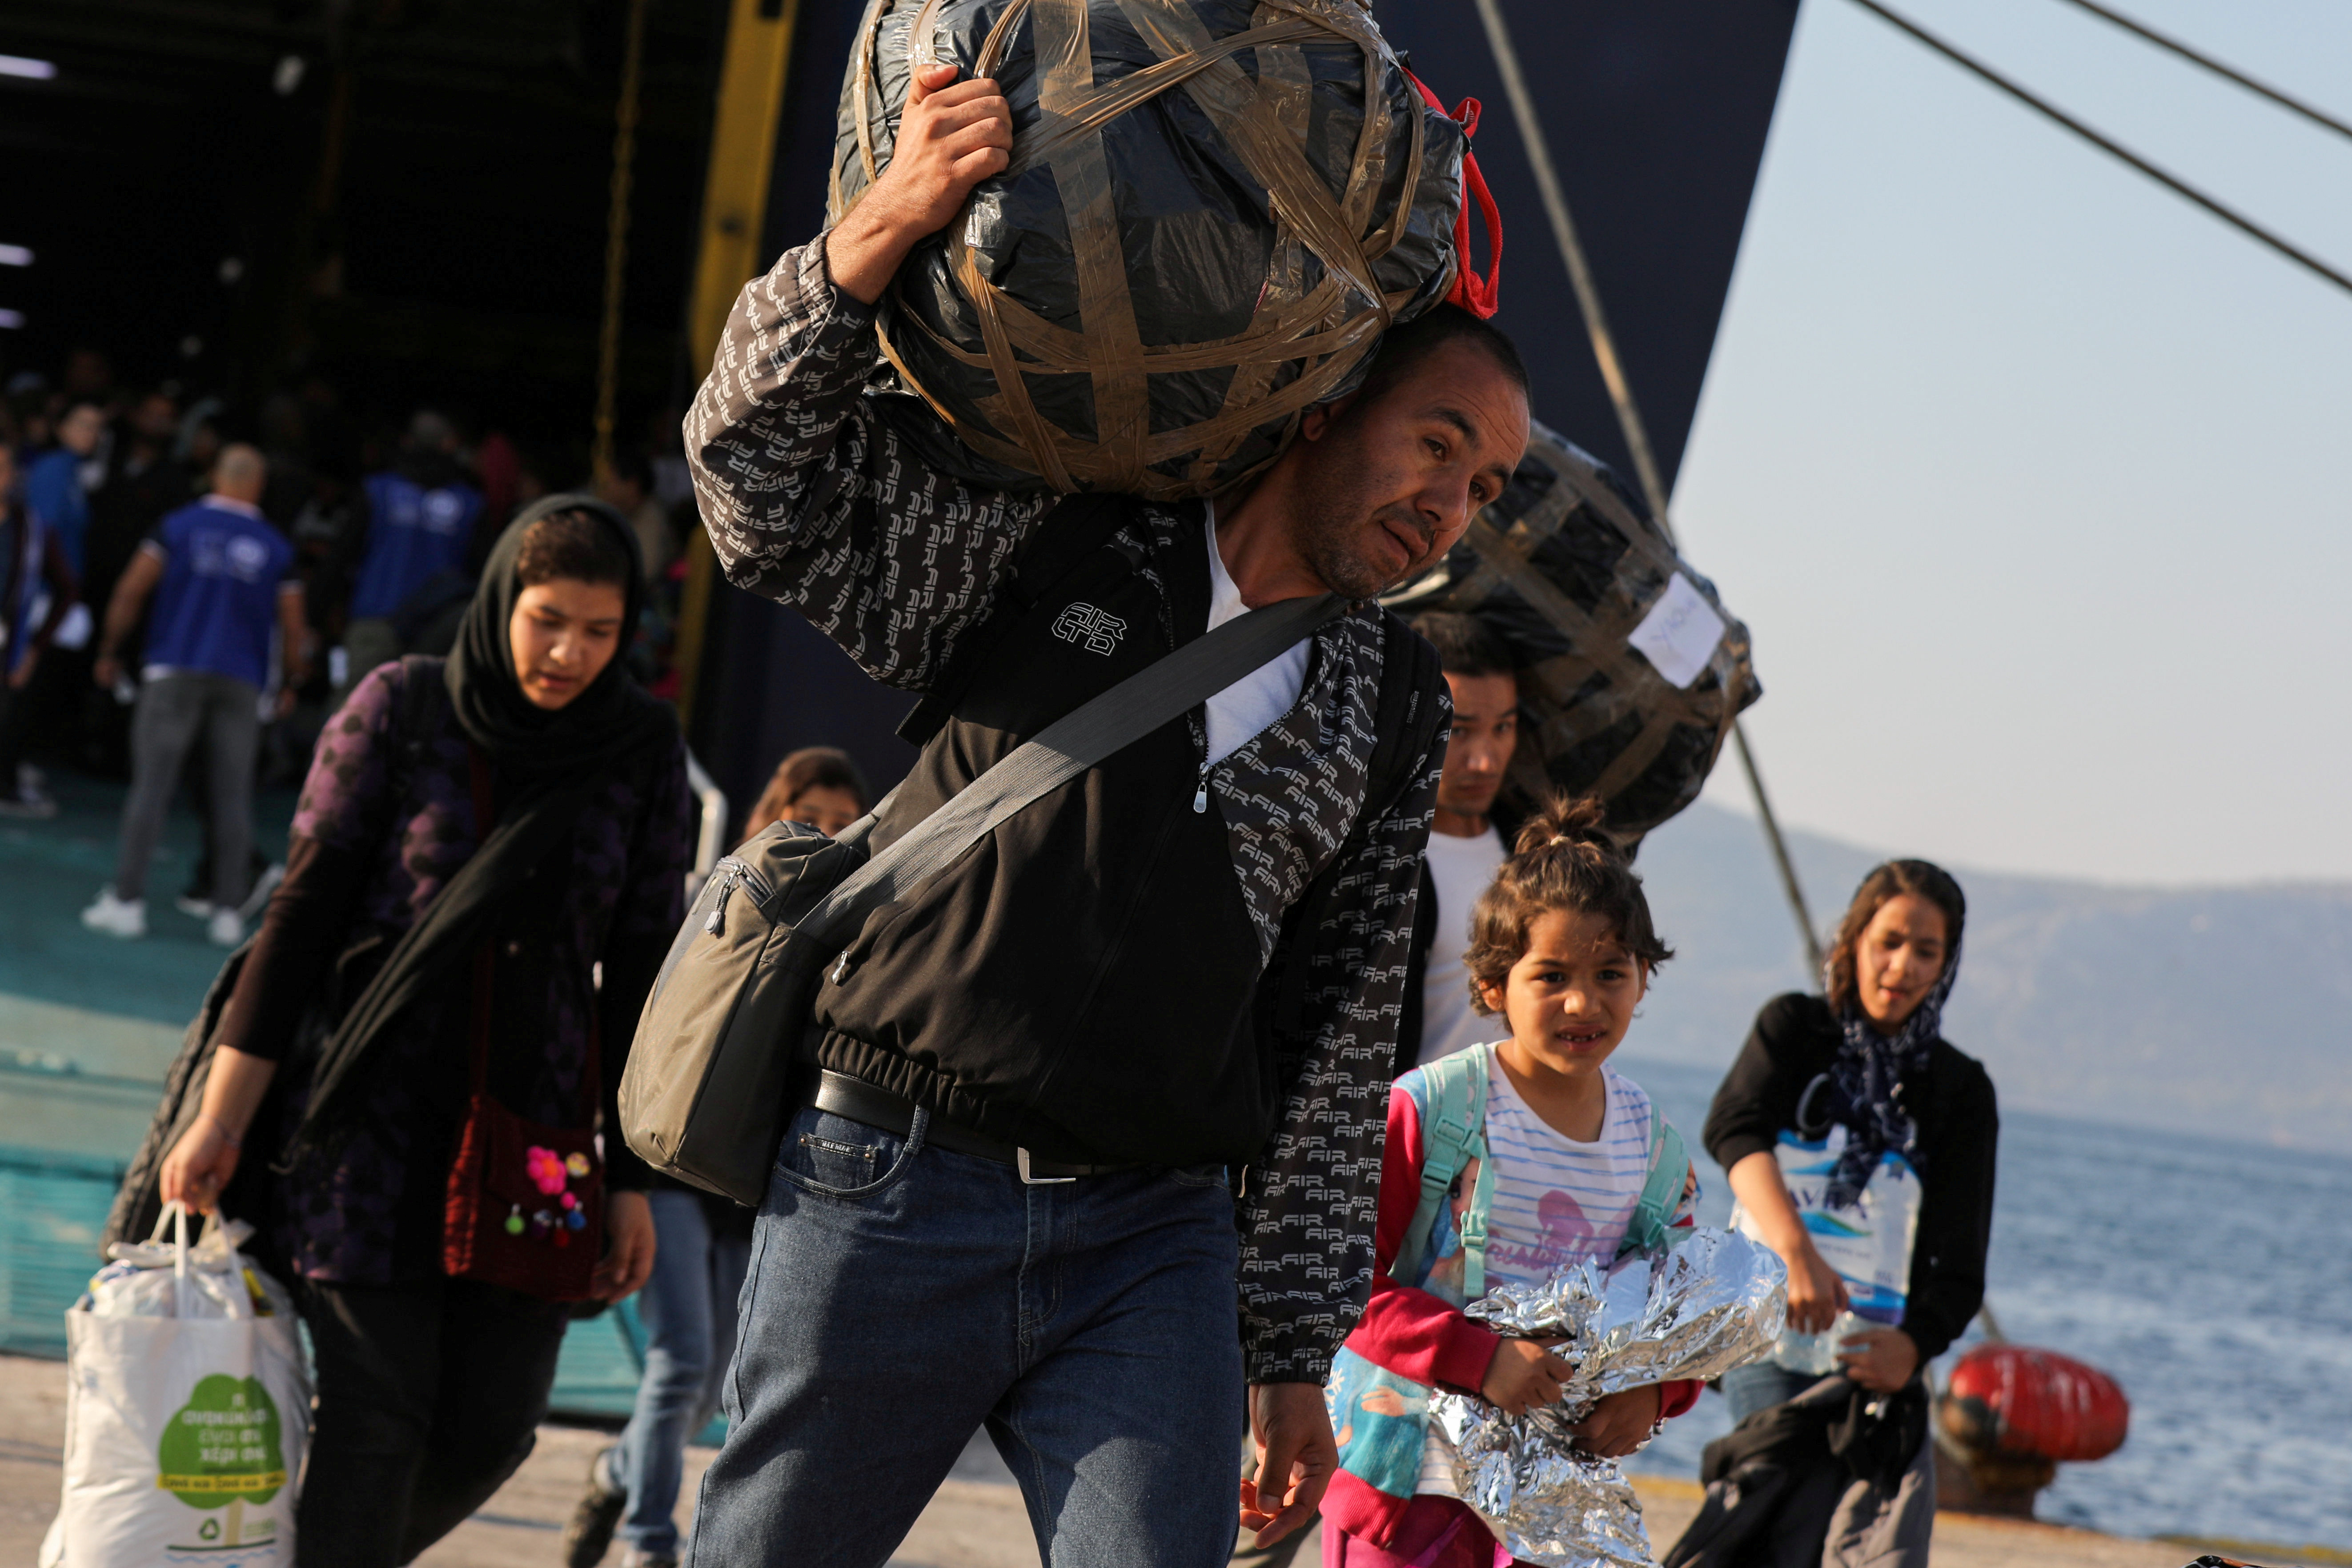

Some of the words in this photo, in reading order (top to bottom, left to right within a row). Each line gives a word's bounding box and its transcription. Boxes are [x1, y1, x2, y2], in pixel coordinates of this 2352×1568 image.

[776, 295, 801, 333] AIR
[750, 312, 769, 351] AIR
[778, 321, 799, 362] AIR
[722, 328, 737, 369] AIR
[747, 339, 762, 380] AIR
[718, 356, 733, 399] AIR
[738, 365, 763, 406] AIR
[714, 384, 736, 426] AIR
[698, 404, 711, 446] AIR
[749, 422, 794, 448] AIR
[798, 419, 839, 438] AIR
[712, 439, 757, 459] AIR
[766, 444, 812, 461] AIR
[698, 460, 734, 491] AIR
[727, 454, 771, 481] AIR
[882, 459, 901, 504] AIR
[921, 472, 936, 516] AIR
[698, 478, 727, 515] AIR
[715, 484, 754, 514] AIR
[956, 486, 971, 522] AIR
[712, 506, 746, 539] AIR
[821, 499, 851, 539] AIR
[902, 491, 921, 536] AIR
[987, 491, 1005, 529] AIR
[798, 510, 828, 549] AIR
[883, 513, 902, 557] AIR
[941, 502, 957, 545] AIR
[971, 505, 988, 549] AIR
[922, 524, 941, 566] AIR
[988, 536, 1007, 571] AIR
[799, 548, 830, 586] AIR
[883, 559, 900, 600] AIR
[920, 567, 939, 610] AIR
[955, 573, 975, 610] AIR
[856, 585, 873, 630] AIR
[902, 589, 920, 630] AIR
[885, 608, 902, 647] AIR
[1061, 602, 1127, 640] AIR
[1051, 616, 1115, 656] LTD
[877, 647, 900, 678] AIR
[1342, 716, 1373, 744] AIR
[1233, 750, 1271, 775] AIR
[1306, 758, 1337, 783] AIR
[1336, 745, 1364, 776] AIR
[1272, 766, 1309, 791] AIR
[1211, 779, 1250, 806] AIR
[1284, 786, 1319, 817] AIR
[1315, 778, 1344, 809] AIR
[1251, 794, 1291, 823] AIR
[1343, 796, 1355, 821] AIR
[1233, 822, 1262, 846] AIR
[1298, 811, 1322, 842] AIR
[1381, 817, 1424, 832] AIR
[1268, 832, 1291, 856] AIR
[1322, 828, 1336, 854] AIR
[1360, 845, 1397, 861] AIR
[1239, 842, 1274, 870] AIR
[1290, 847, 1310, 874] AIR
[1378, 854, 1416, 871] AIR
[1253, 866, 1281, 896] AIR
[1285, 865, 1303, 893] AIR
[1338, 871, 1375, 889] AIR
[1362, 883, 1390, 897] AIR
[1240, 882, 1256, 905] IR
[1373, 893, 1407, 910] AIR
[1350, 919, 1385, 934] AIR
[1350, 1009, 1378, 1021] AIR
[1340, 1047, 1373, 1059] AIR
[1322, 1072, 1354, 1084] AIR
[1310, 1097, 1330, 1109] AIR
[1337, 1086, 1368, 1098] AIR
[1313, 1111, 1351, 1123] AIR
[1363, 1119, 1387, 1131] AIR
[1297, 1136, 1327, 1148] AIR
[1334, 1126, 1363, 1137] AIR
[822, 1141, 834, 1149] MAX
[1274, 1146, 1296, 1159] AIR
[1307, 1150, 1347, 1161] AIR
[1331, 1164, 1358, 1176] AIR
[1357, 1158, 1381, 1169] AIR
[1264, 1184, 1285, 1197] AIR
[1286, 1175, 1325, 1187] AIR
[1305, 1189, 1346, 1201] AIR
[1351, 1196, 1375, 1208] AIR
[1282, 1214, 1324, 1226] AIR
[1329, 1203, 1351, 1215] AIR
[1254, 1221, 1282, 1235] AIR
[1305, 1228, 1343, 1239] AIR
[1346, 1235, 1373, 1246] AIR
[1243, 1260, 1282, 1272] AIR
[1281, 1253, 1324, 1265] AIR
[1306, 1267, 1339, 1279] AIR
[1328, 1276, 1363, 1293] AIR
[1239, 1283, 1264, 1295] IR
[1248, 1292, 1290, 1307] AIR
[1286, 1291, 1326, 1302] AIR
[1245, 1315, 1273, 1328] AIR
[1259, 1323, 1294, 1342] AIR
[1295, 1314, 1336, 1327] AIR
[1312, 1326, 1347, 1339] AIR
